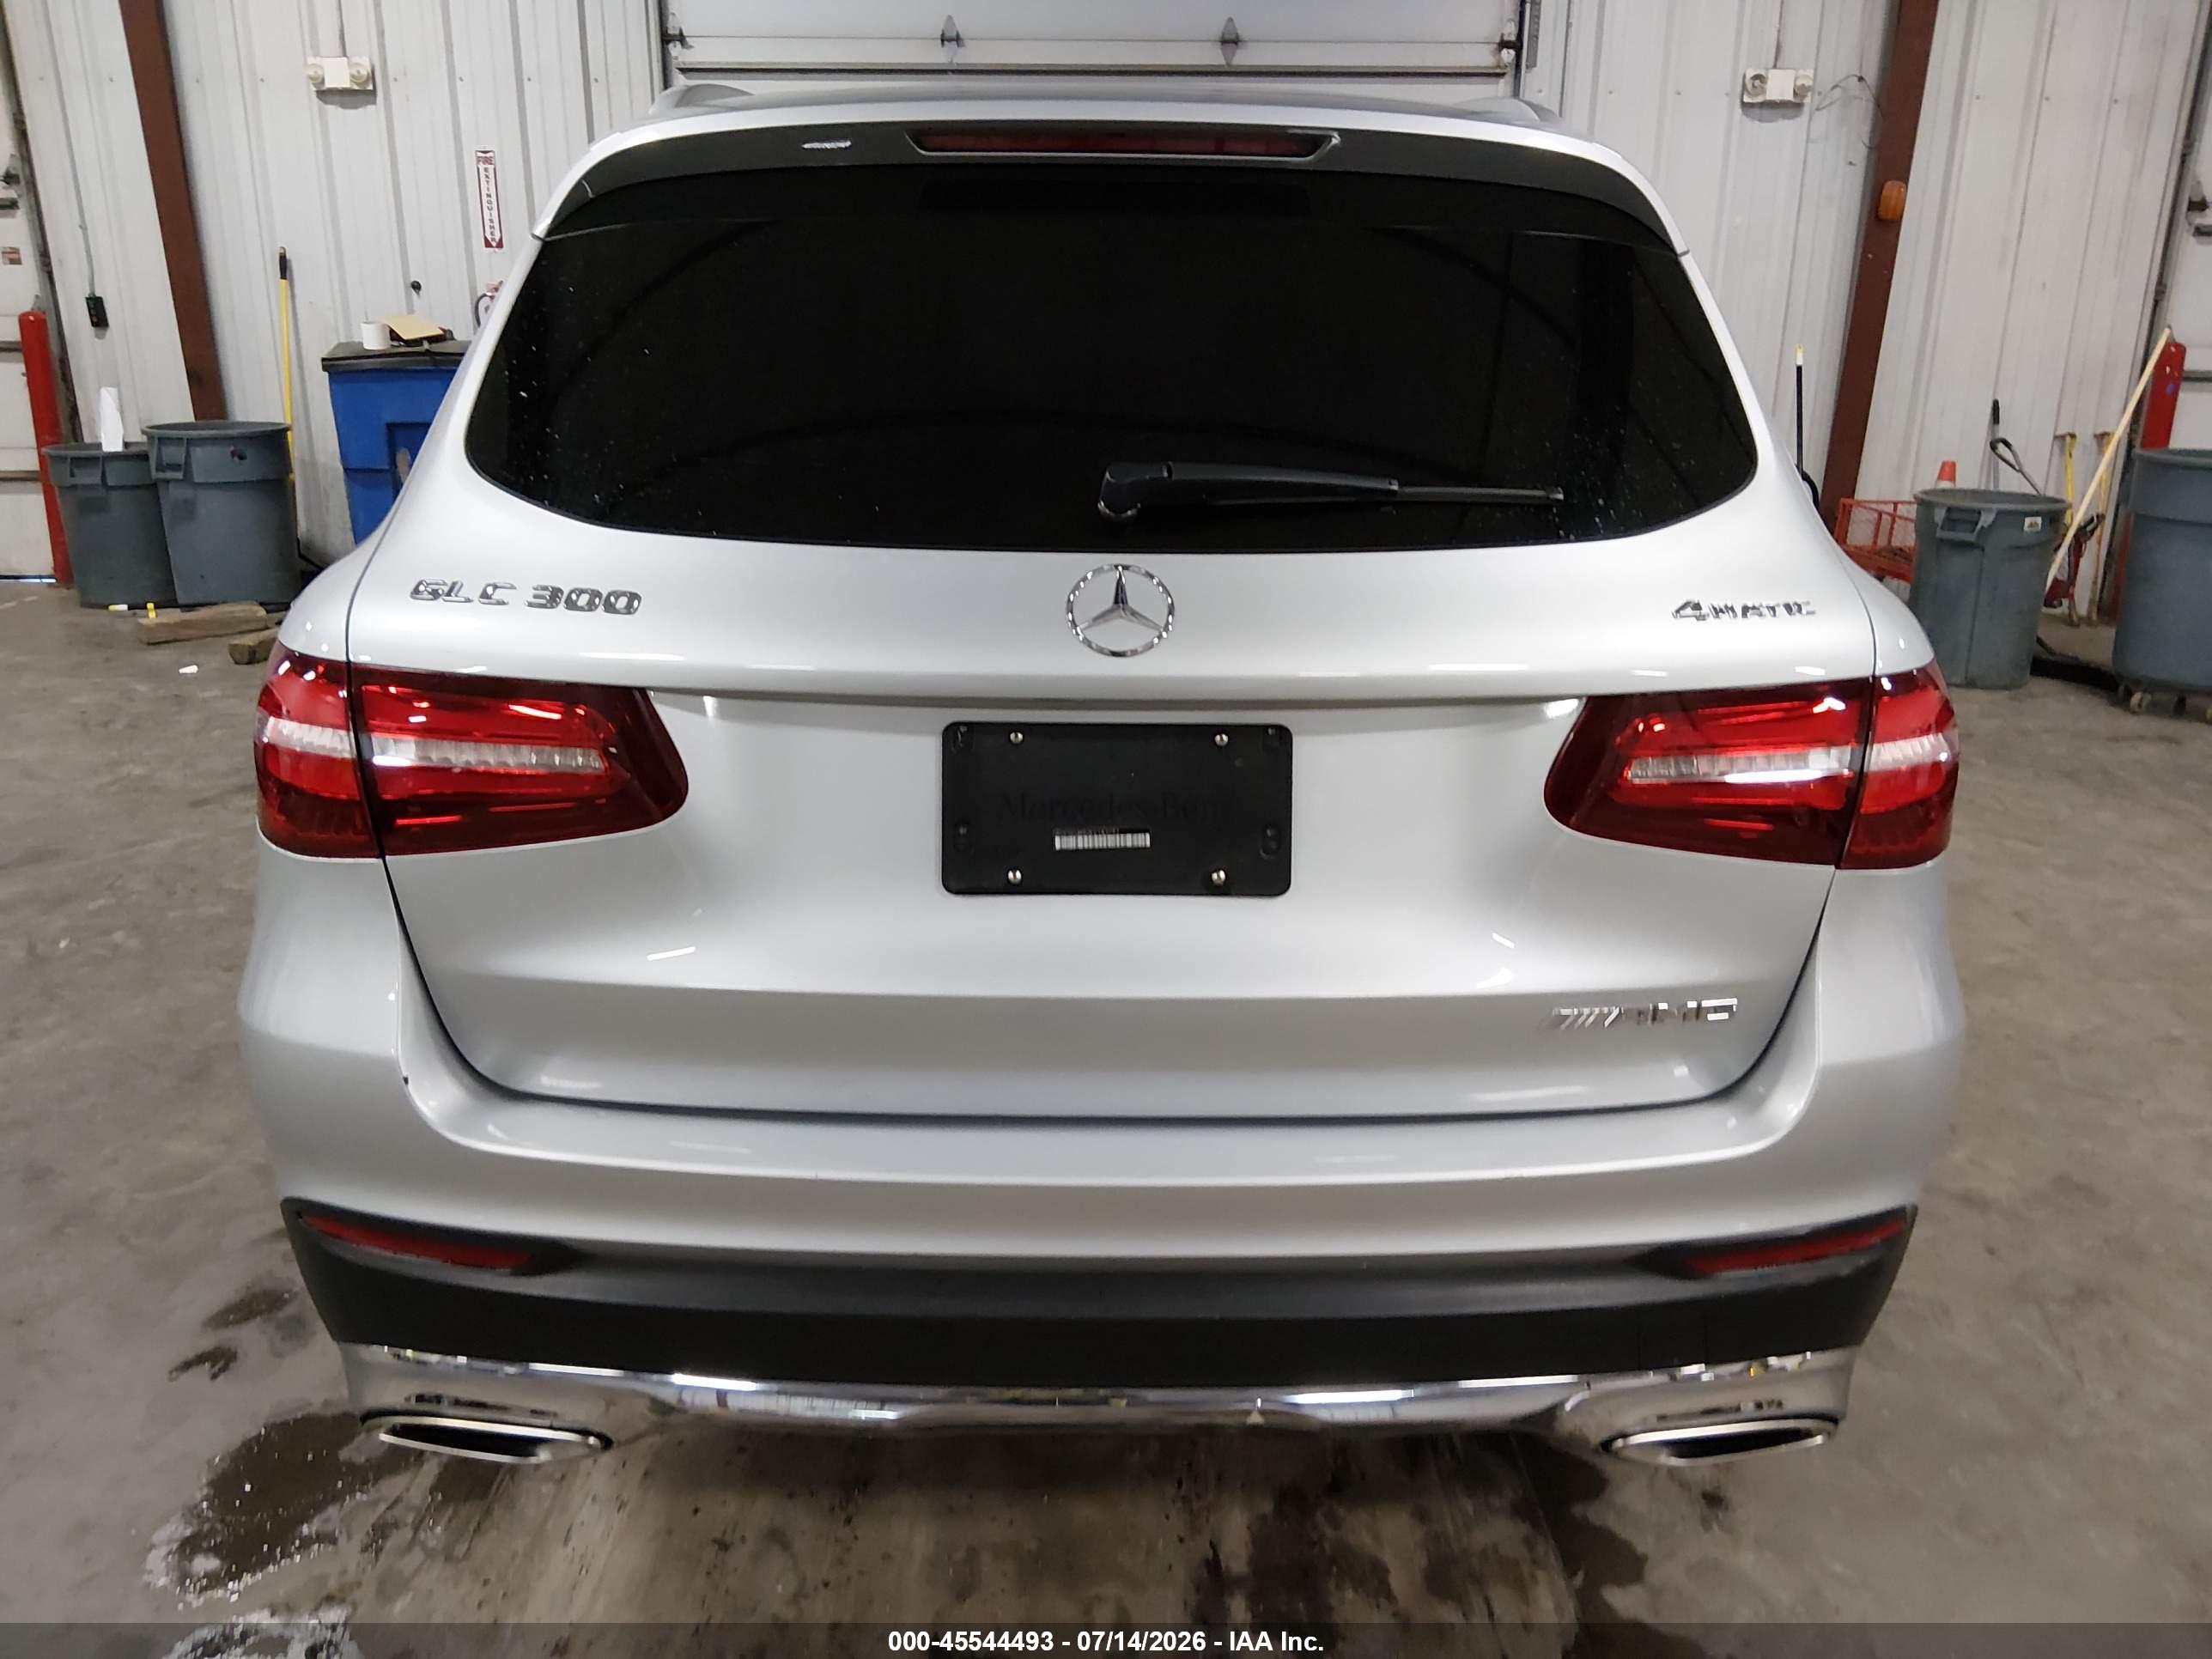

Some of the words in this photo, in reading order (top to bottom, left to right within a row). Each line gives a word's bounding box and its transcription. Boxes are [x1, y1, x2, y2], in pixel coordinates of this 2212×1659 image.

[477, 156, 494, 165] FIRE
[483, 167, 496, 243] EXTINGUISHER
[410, 578, 517, 605] GLC
[524, 584, 642, 615] 300
[1672, 599, 1816, 621] 4MATIC
